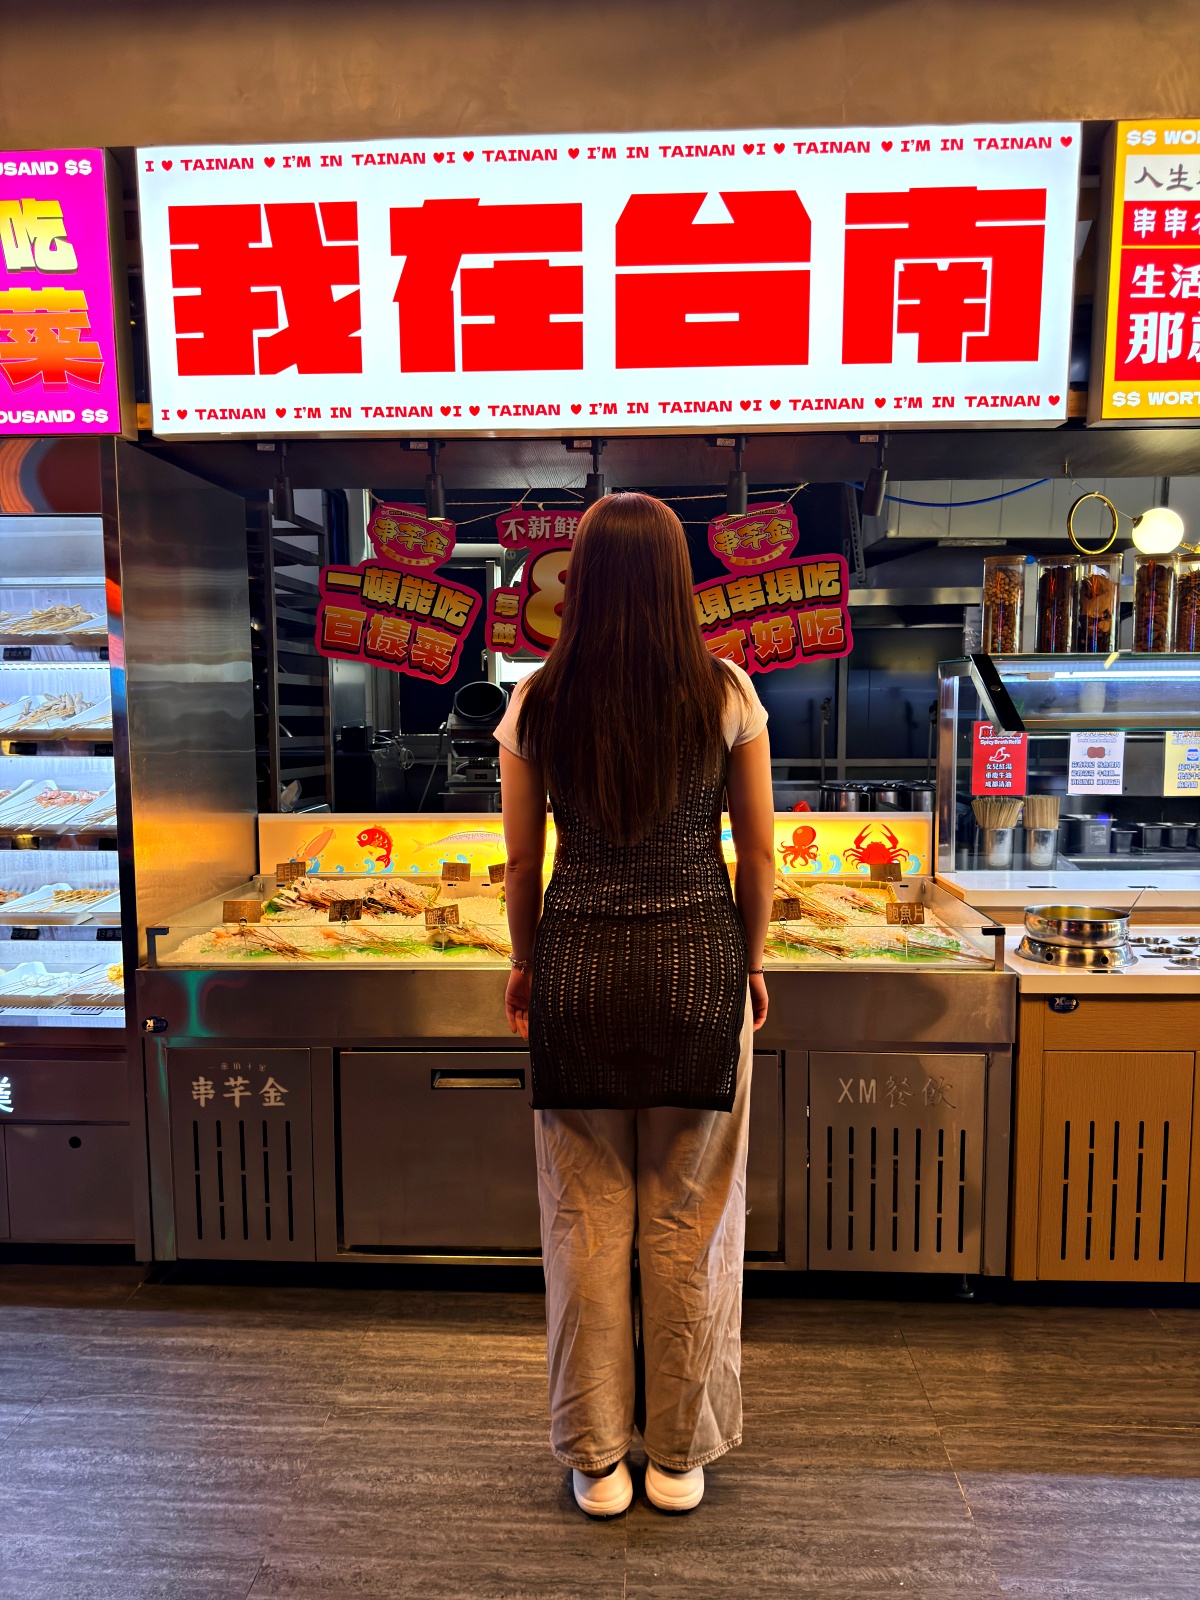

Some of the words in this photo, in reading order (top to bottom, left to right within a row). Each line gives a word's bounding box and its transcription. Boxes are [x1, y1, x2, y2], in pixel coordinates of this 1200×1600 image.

[0, 161, 59, 176] SAND
[64, 160, 92, 176] $$
[144, 160, 154, 173] I
[180, 157, 254, 172] TAINAN
[282, 155, 312, 169] I'M
[320, 154, 343, 168] IN
[351, 152, 426, 166] TAINAN
[445, 151, 456, 164] I
[481, 149, 558, 163] TAINAN
[587, 146, 617, 160] I'M
[626, 146, 649, 159] IN
[658, 144, 735, 158] TAINAN
[755, 143, 766, 156] I
[793, 141, 871, 155] TAINAN
[900, 139, 931, 153] I'M
[940, 138, 964, 151] IN
[973, 136, 1052, 150] TAINAN
[1134, 163, 1200, 191] 人生
[0, 198, 79, 273] 吃
[168, 186, 1047, 377] 我在台南
[0, 287, 105, 393] 菜
[1124, 310, 1200, 365] 那
[81, 408, 109, 424] $$
[161, 409, 170, 421] I
[194, 408, 266, 421] TAINAN
[293, 406, 322, 420] I'M
[330, 406, 352, 419] IN
[360, 405, 433, 418] TAINAN
[452, 405, 462, 417] I
[487, 404, 561, 417] TAINAN
[589, 402, 618, 416] I'M
[626, 402, 649, 415] IN
[657, 400, 733, 414] TAINAN
[752, 399, 763, 412] I
[788, 397, 865, 411] TAINAN
[893, 396, 923, 410] I'M
[932, 396, 955, 409] IN
[964, 395, 1041, 409] TAINAN
[372, 517, 451, 557] 串芋金
[714, 517, 794, 555] 串芋金
[325, 566, 476, 631] 一頓能吃
[693, 562, 842, 626] 現串現吃
[323, 604, 458, 674] 百樣菜
[705, 607, 845, 666] 才好吃
[1178, 763, 1200, 771] 起司牛
[887, 904, 924, 922] 鮑魚片
[191, 1075, 289, 1108] 串芋金
